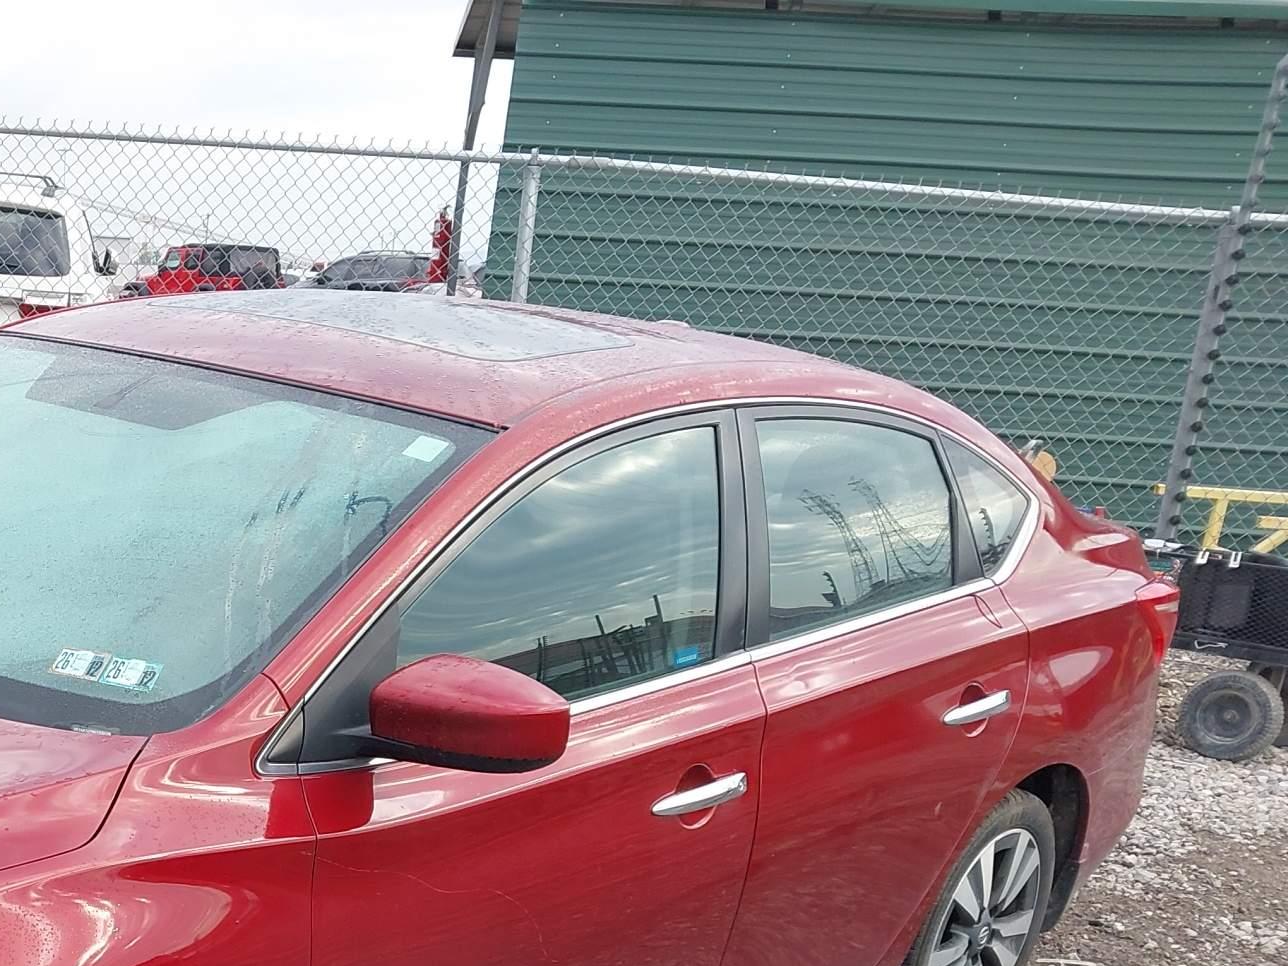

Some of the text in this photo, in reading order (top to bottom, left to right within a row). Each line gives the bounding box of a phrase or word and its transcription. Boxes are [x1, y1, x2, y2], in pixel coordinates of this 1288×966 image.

[54, 651, 104, 678] 26 12
[106, 659, 157, 687] 26 12
